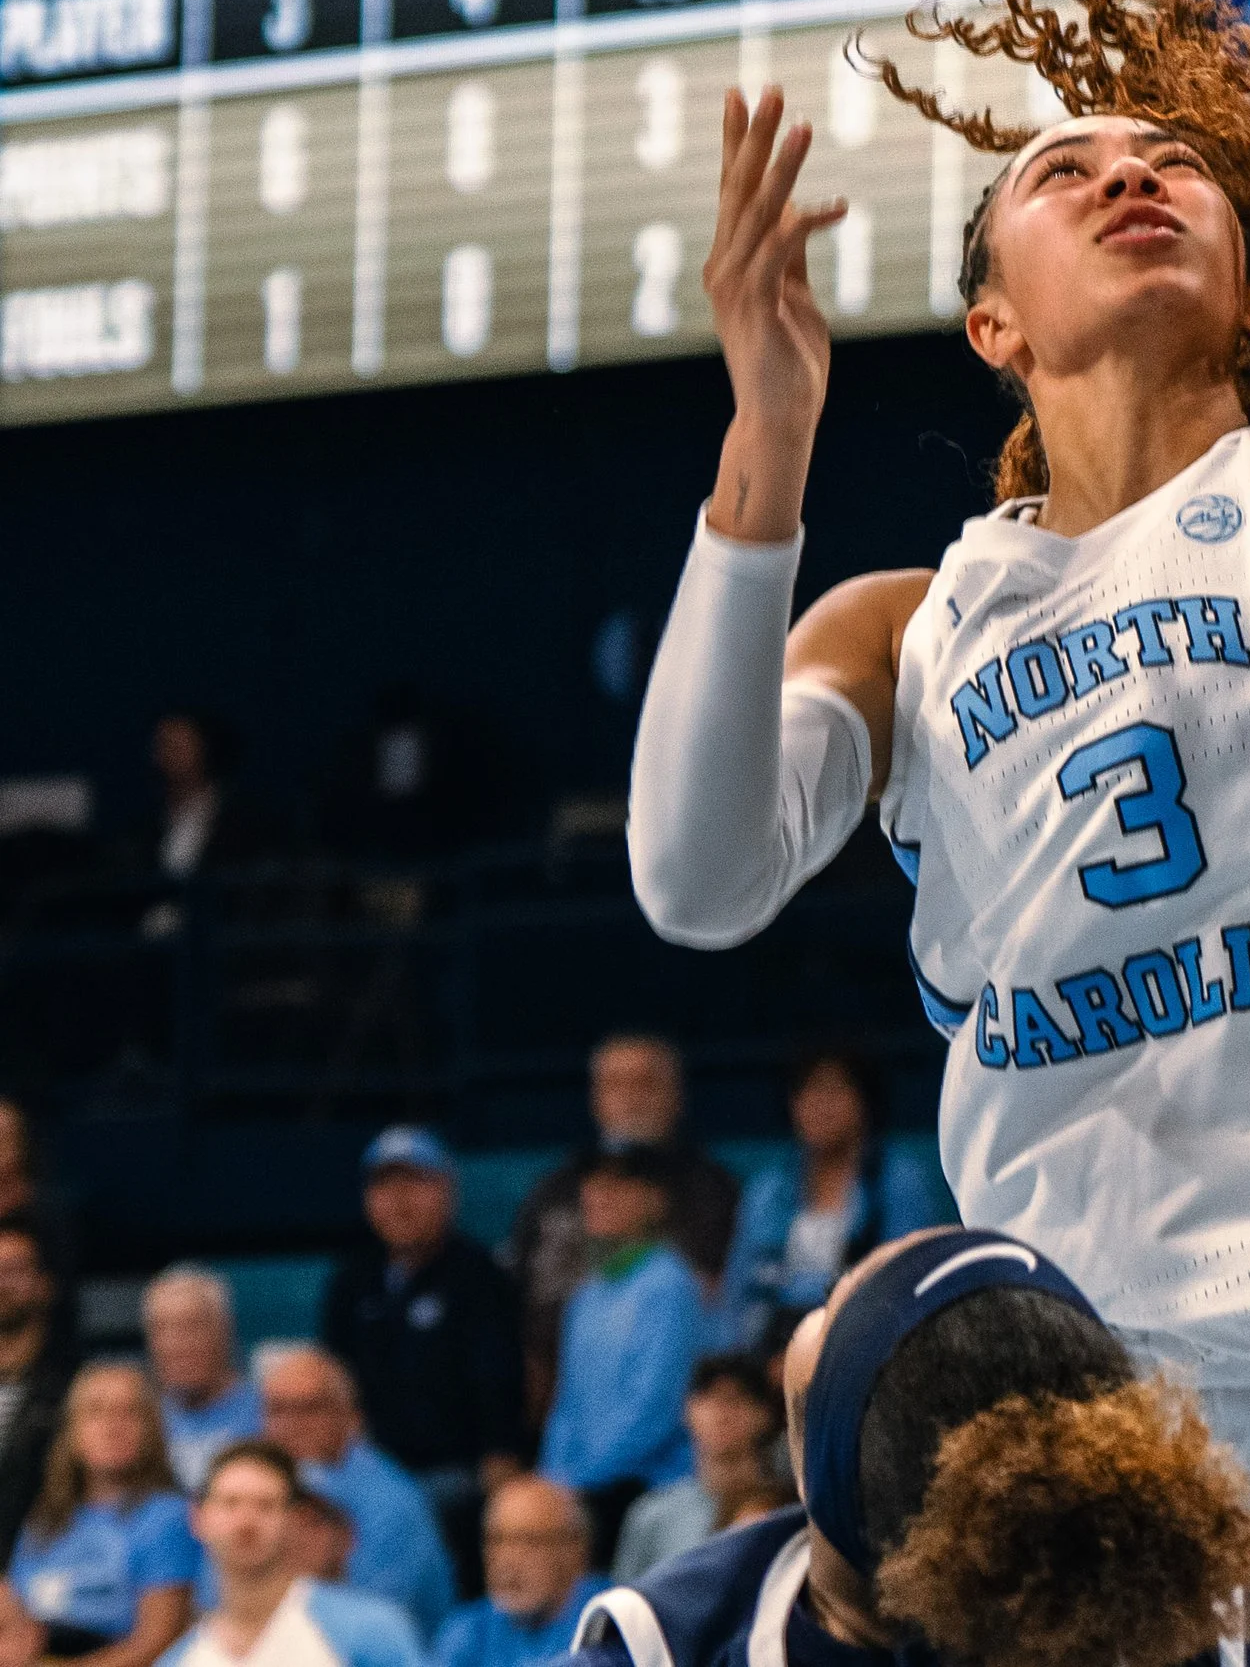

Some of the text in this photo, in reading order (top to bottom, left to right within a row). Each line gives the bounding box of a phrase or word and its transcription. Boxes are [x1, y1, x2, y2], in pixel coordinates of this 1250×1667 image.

[263, 263, 301, 376] 1
[632, 224, 681, 335] 2
[1056, 721, 1208, 909] 3
